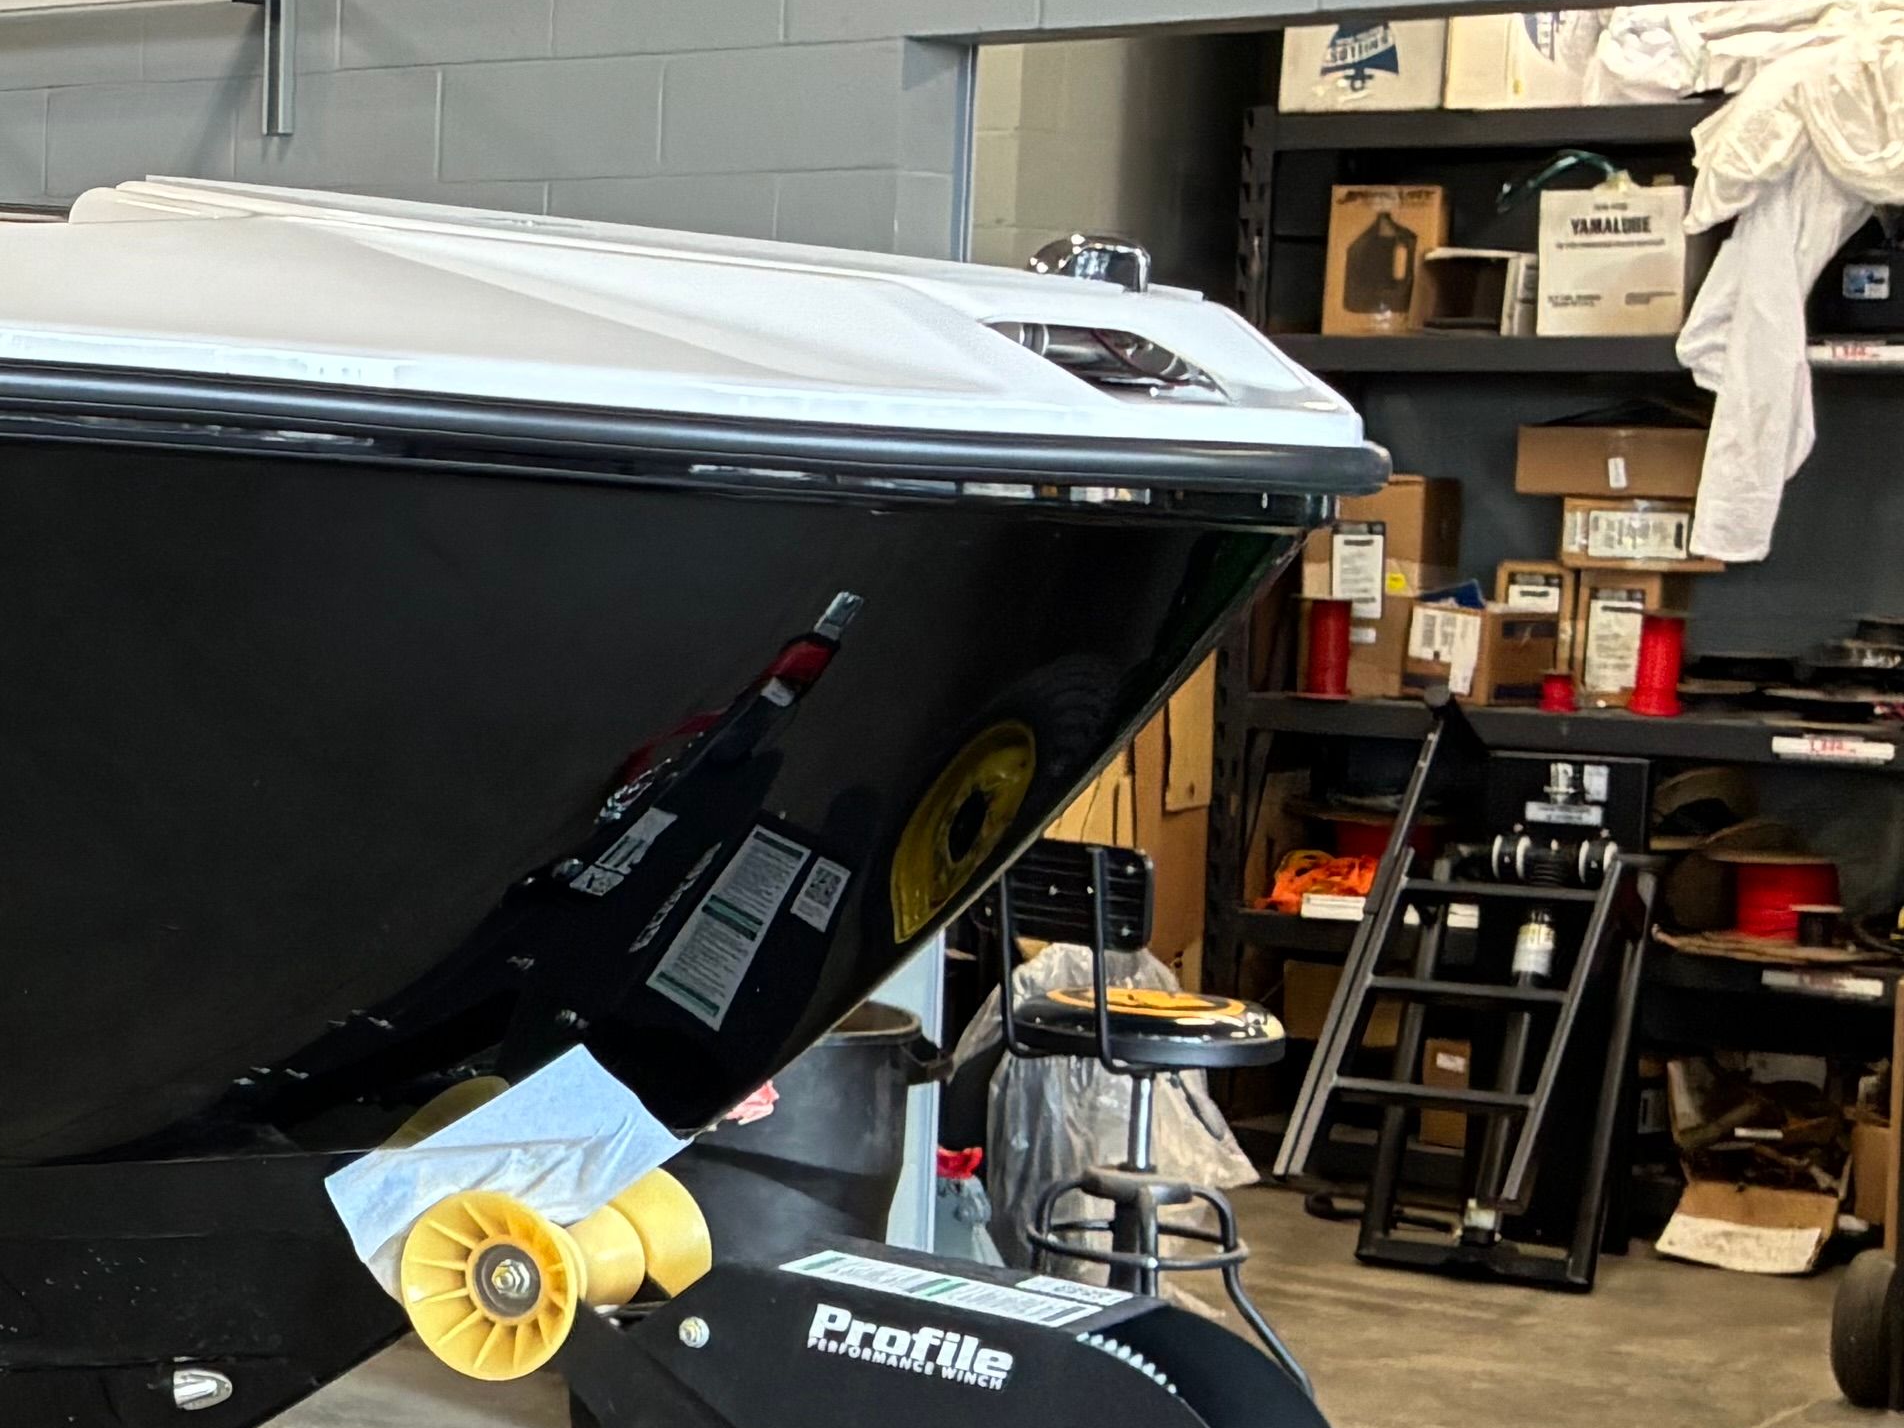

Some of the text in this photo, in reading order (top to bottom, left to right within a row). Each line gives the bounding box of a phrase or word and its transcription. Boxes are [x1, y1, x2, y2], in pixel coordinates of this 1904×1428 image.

[807, 1337, 1004, 1390] PERFORMANCE WINCH
[808, 1303, 1014, 1380] Profile
